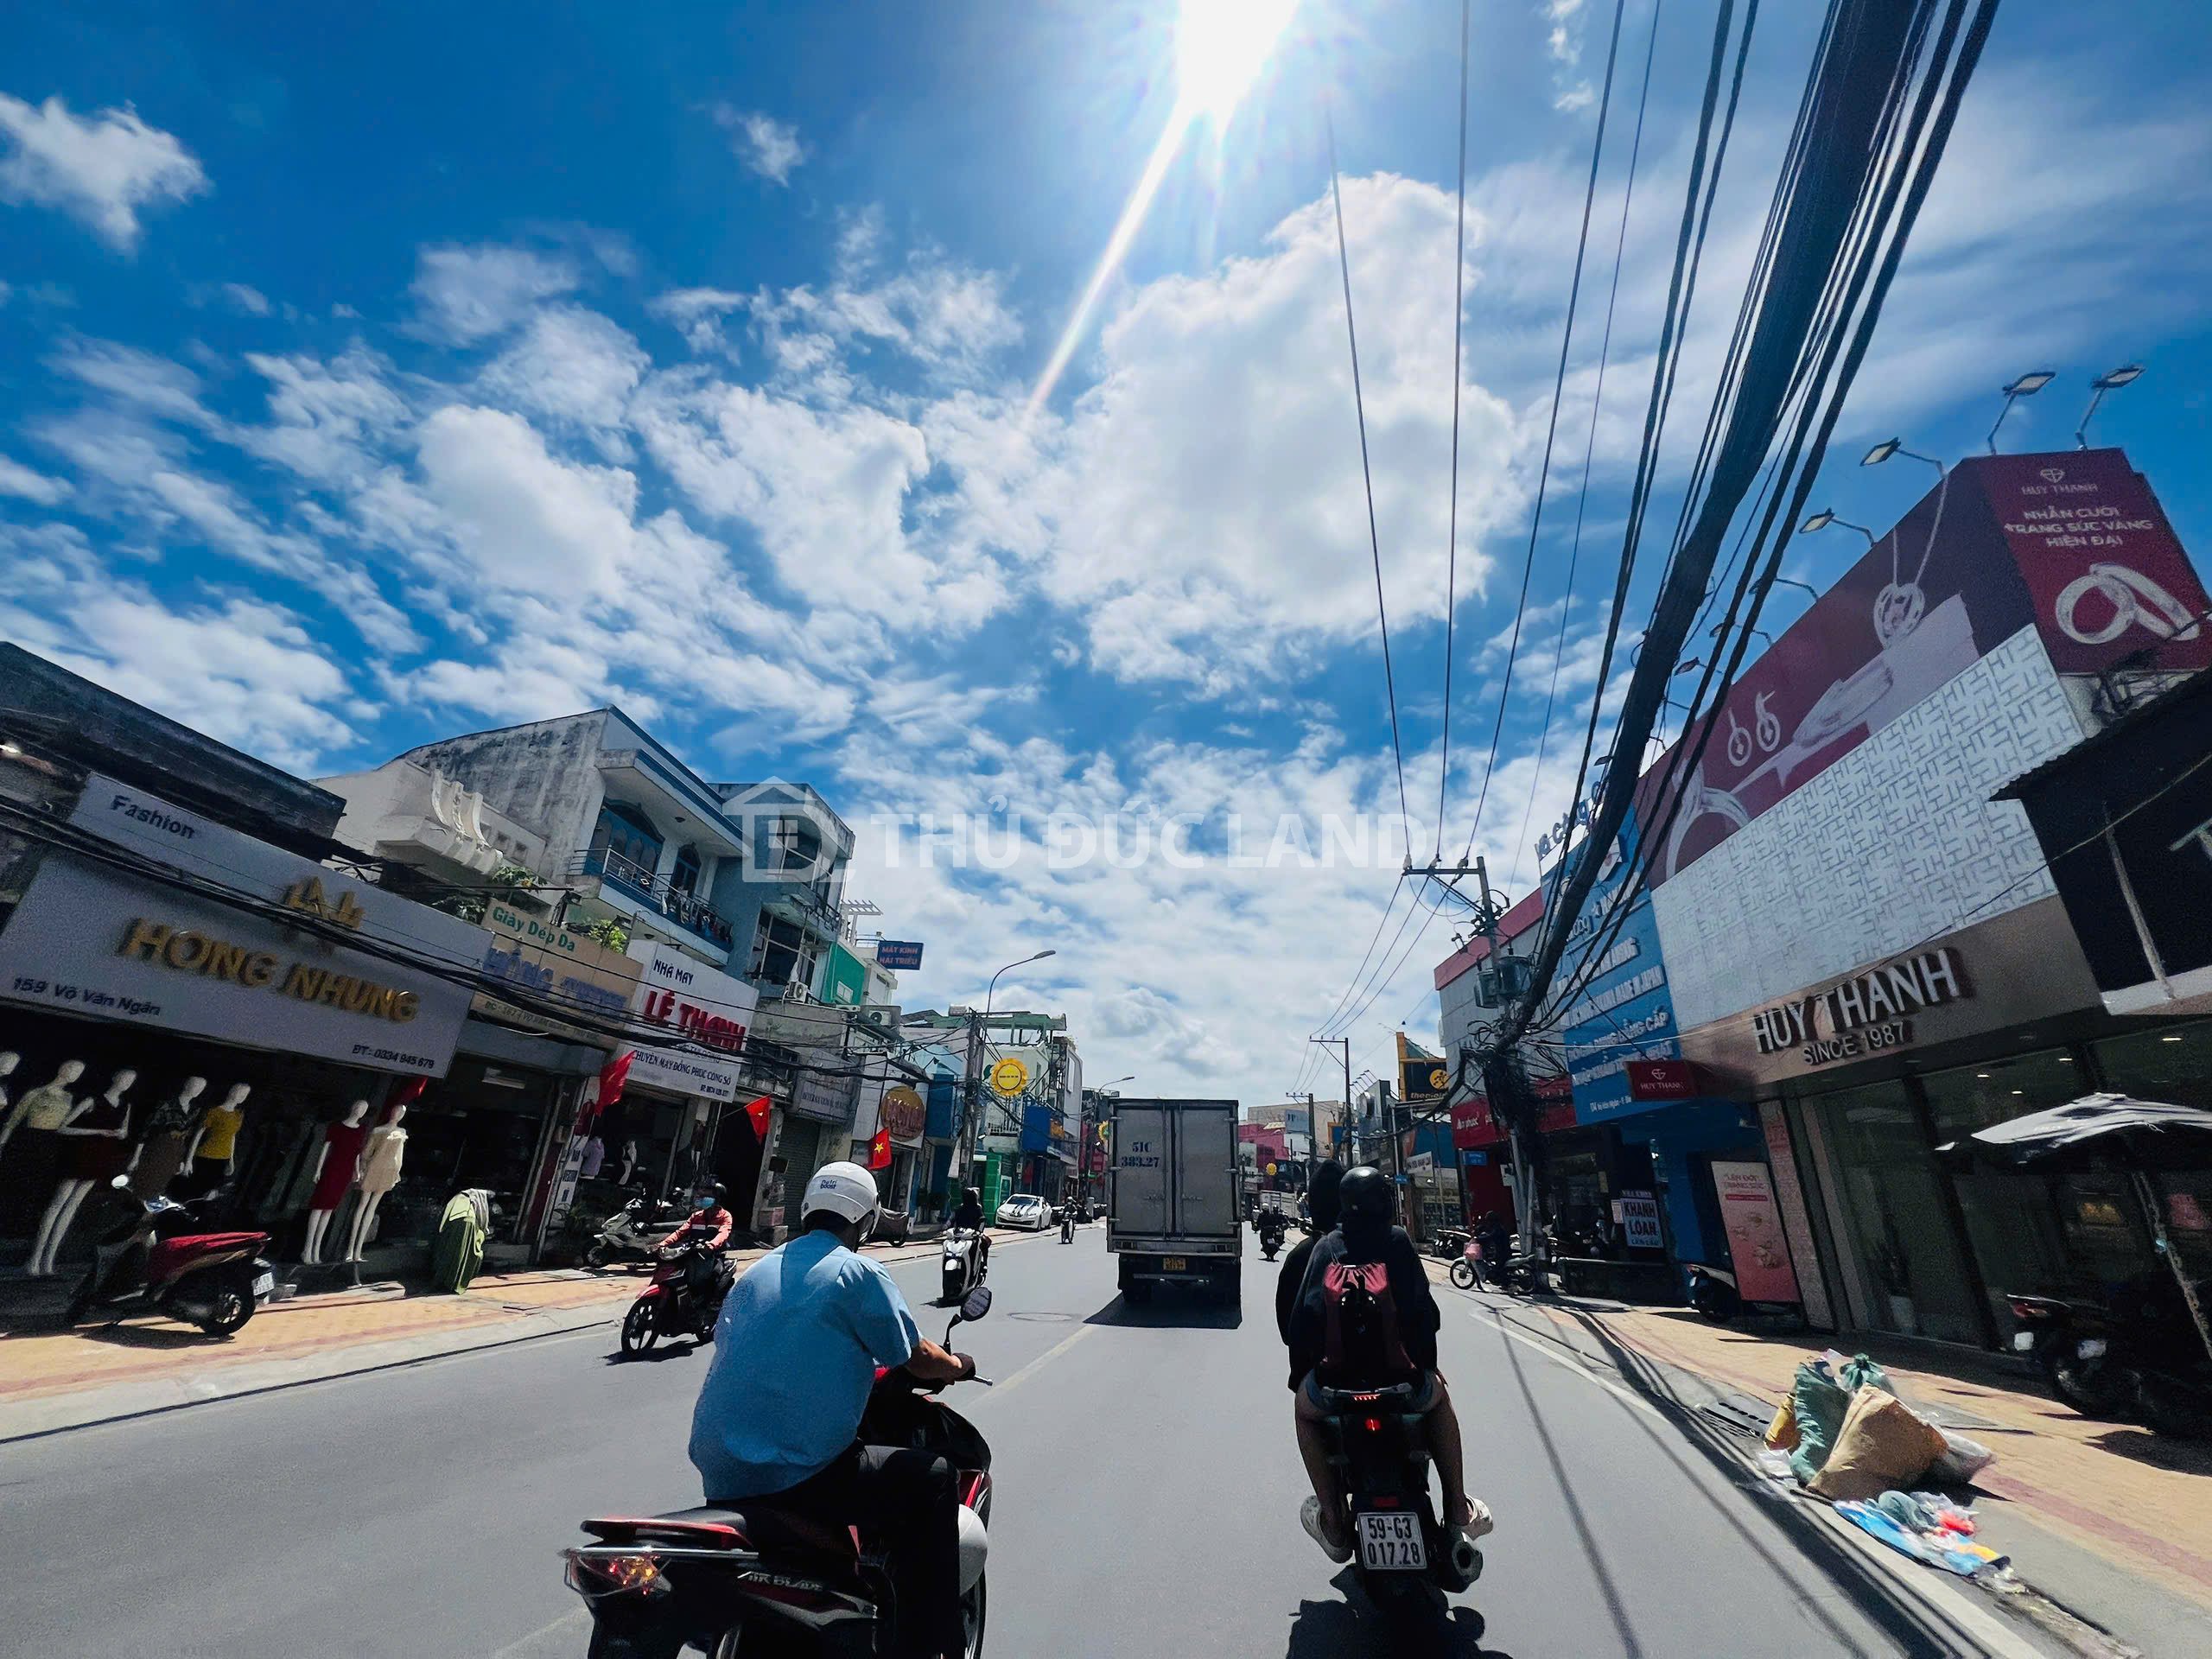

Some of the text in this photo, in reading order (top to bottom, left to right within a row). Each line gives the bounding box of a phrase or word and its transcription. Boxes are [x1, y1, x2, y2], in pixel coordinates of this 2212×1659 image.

[111, 795, 195, 839] Fashion
[493, 906, 576, 951] Giày Dép Da
[13, 977, 48, 994] 159
[675, 969, 694, 986] MAY
[1752, 949, 1960, 1053] HUY THANH
[1802, 1020, 1906, 1066] SINCE 1987
